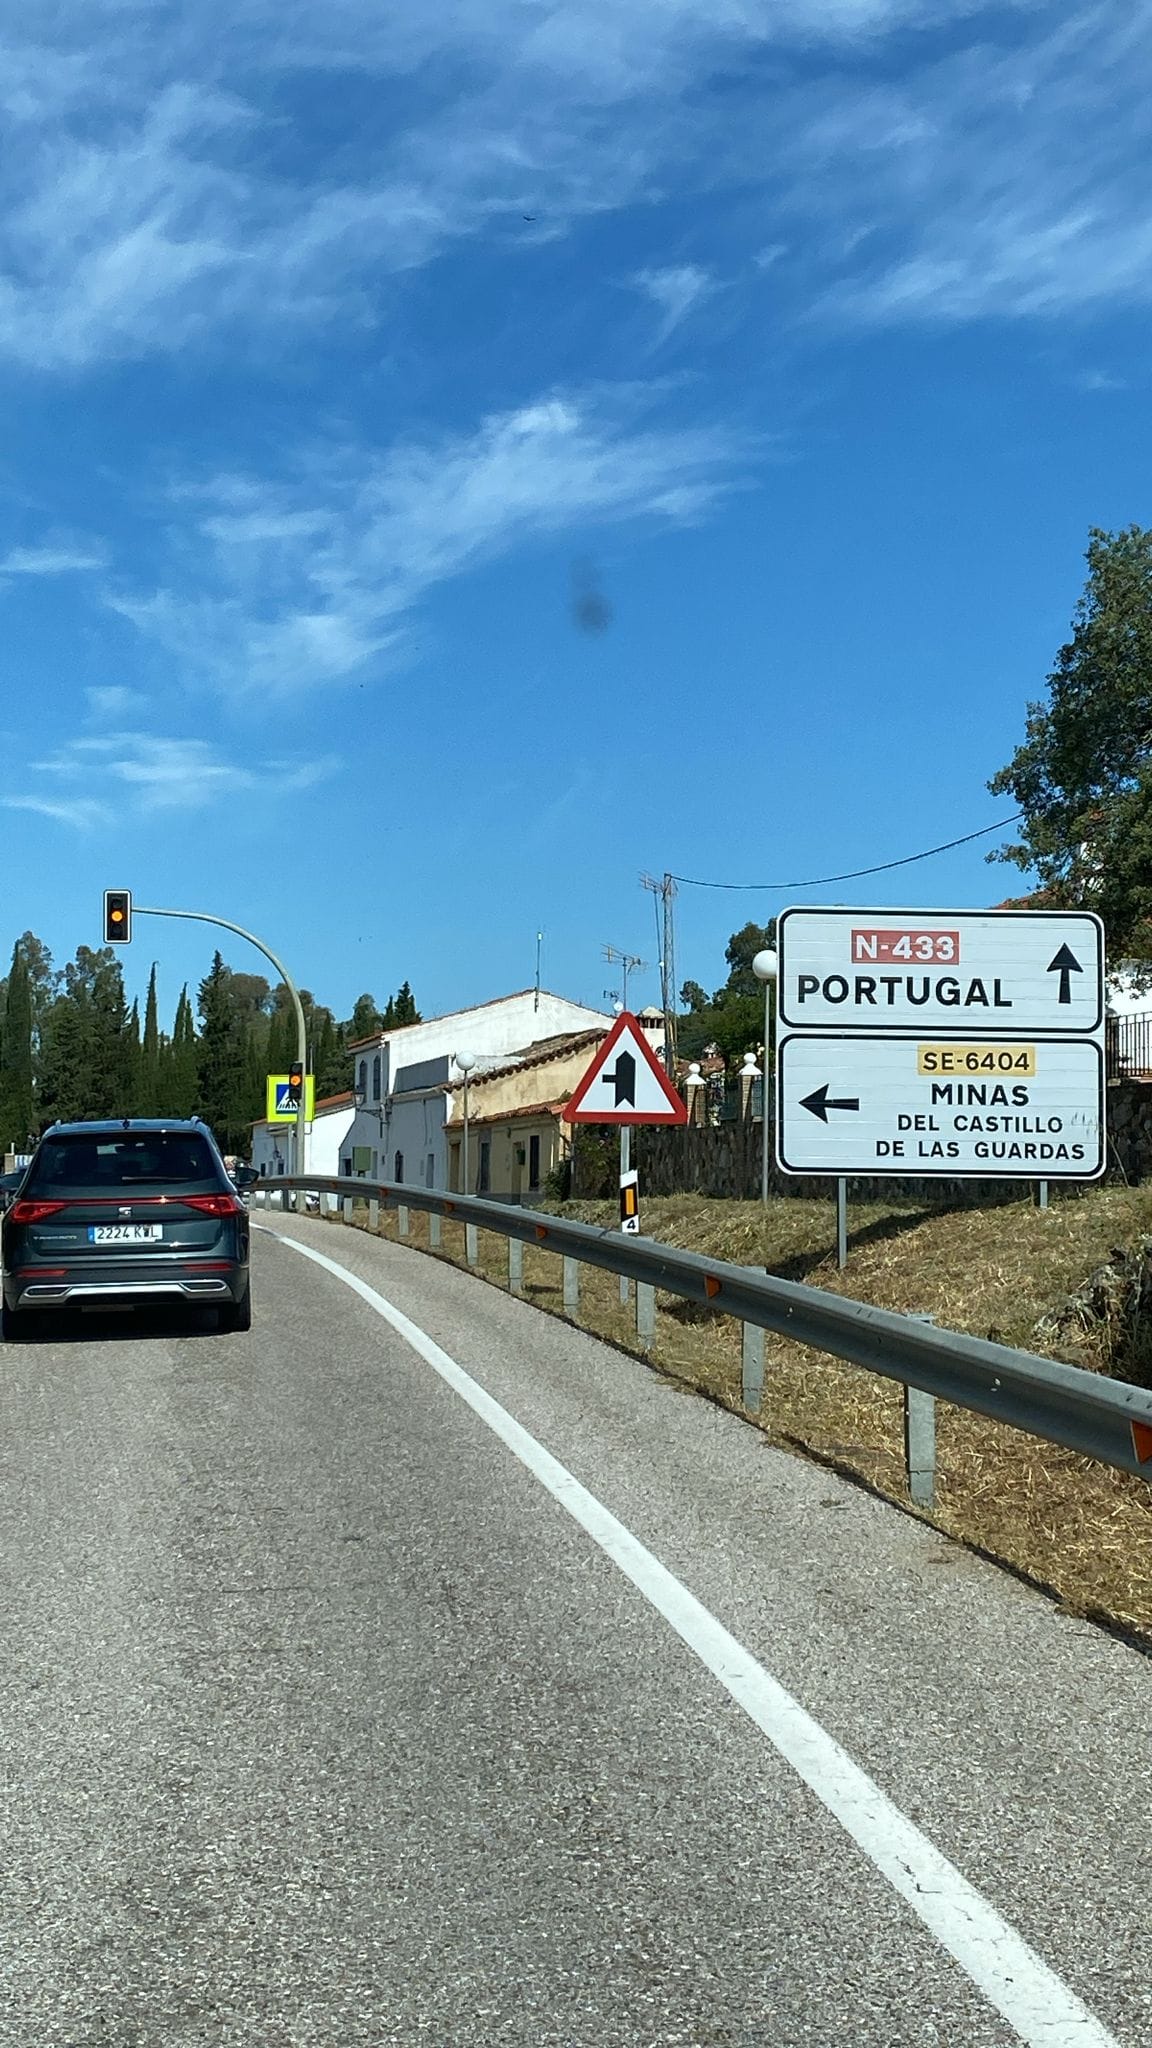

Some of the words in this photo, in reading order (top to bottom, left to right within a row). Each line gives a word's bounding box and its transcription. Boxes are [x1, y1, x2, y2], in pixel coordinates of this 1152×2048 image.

[855, 935, 955, 961] N-433
[798, 975, 1013, 1007] PORTUGAL
[923, 1052, 1030, 1071] SE-6404
[931, 1083, 1029, 1107] MINAS
[897, 1115, 940, 1131] DEL
[953, 1115, 1063, 1133] CASTILLO
[876, 1141, 905, 1157] DE
[918, 1141, 960, 1158] LAS
[974, 1142, 1085, 1160] GUARDAS
[97, 1226, 130, 1240] 2224
[627, 1219, 636, 1230] 4
